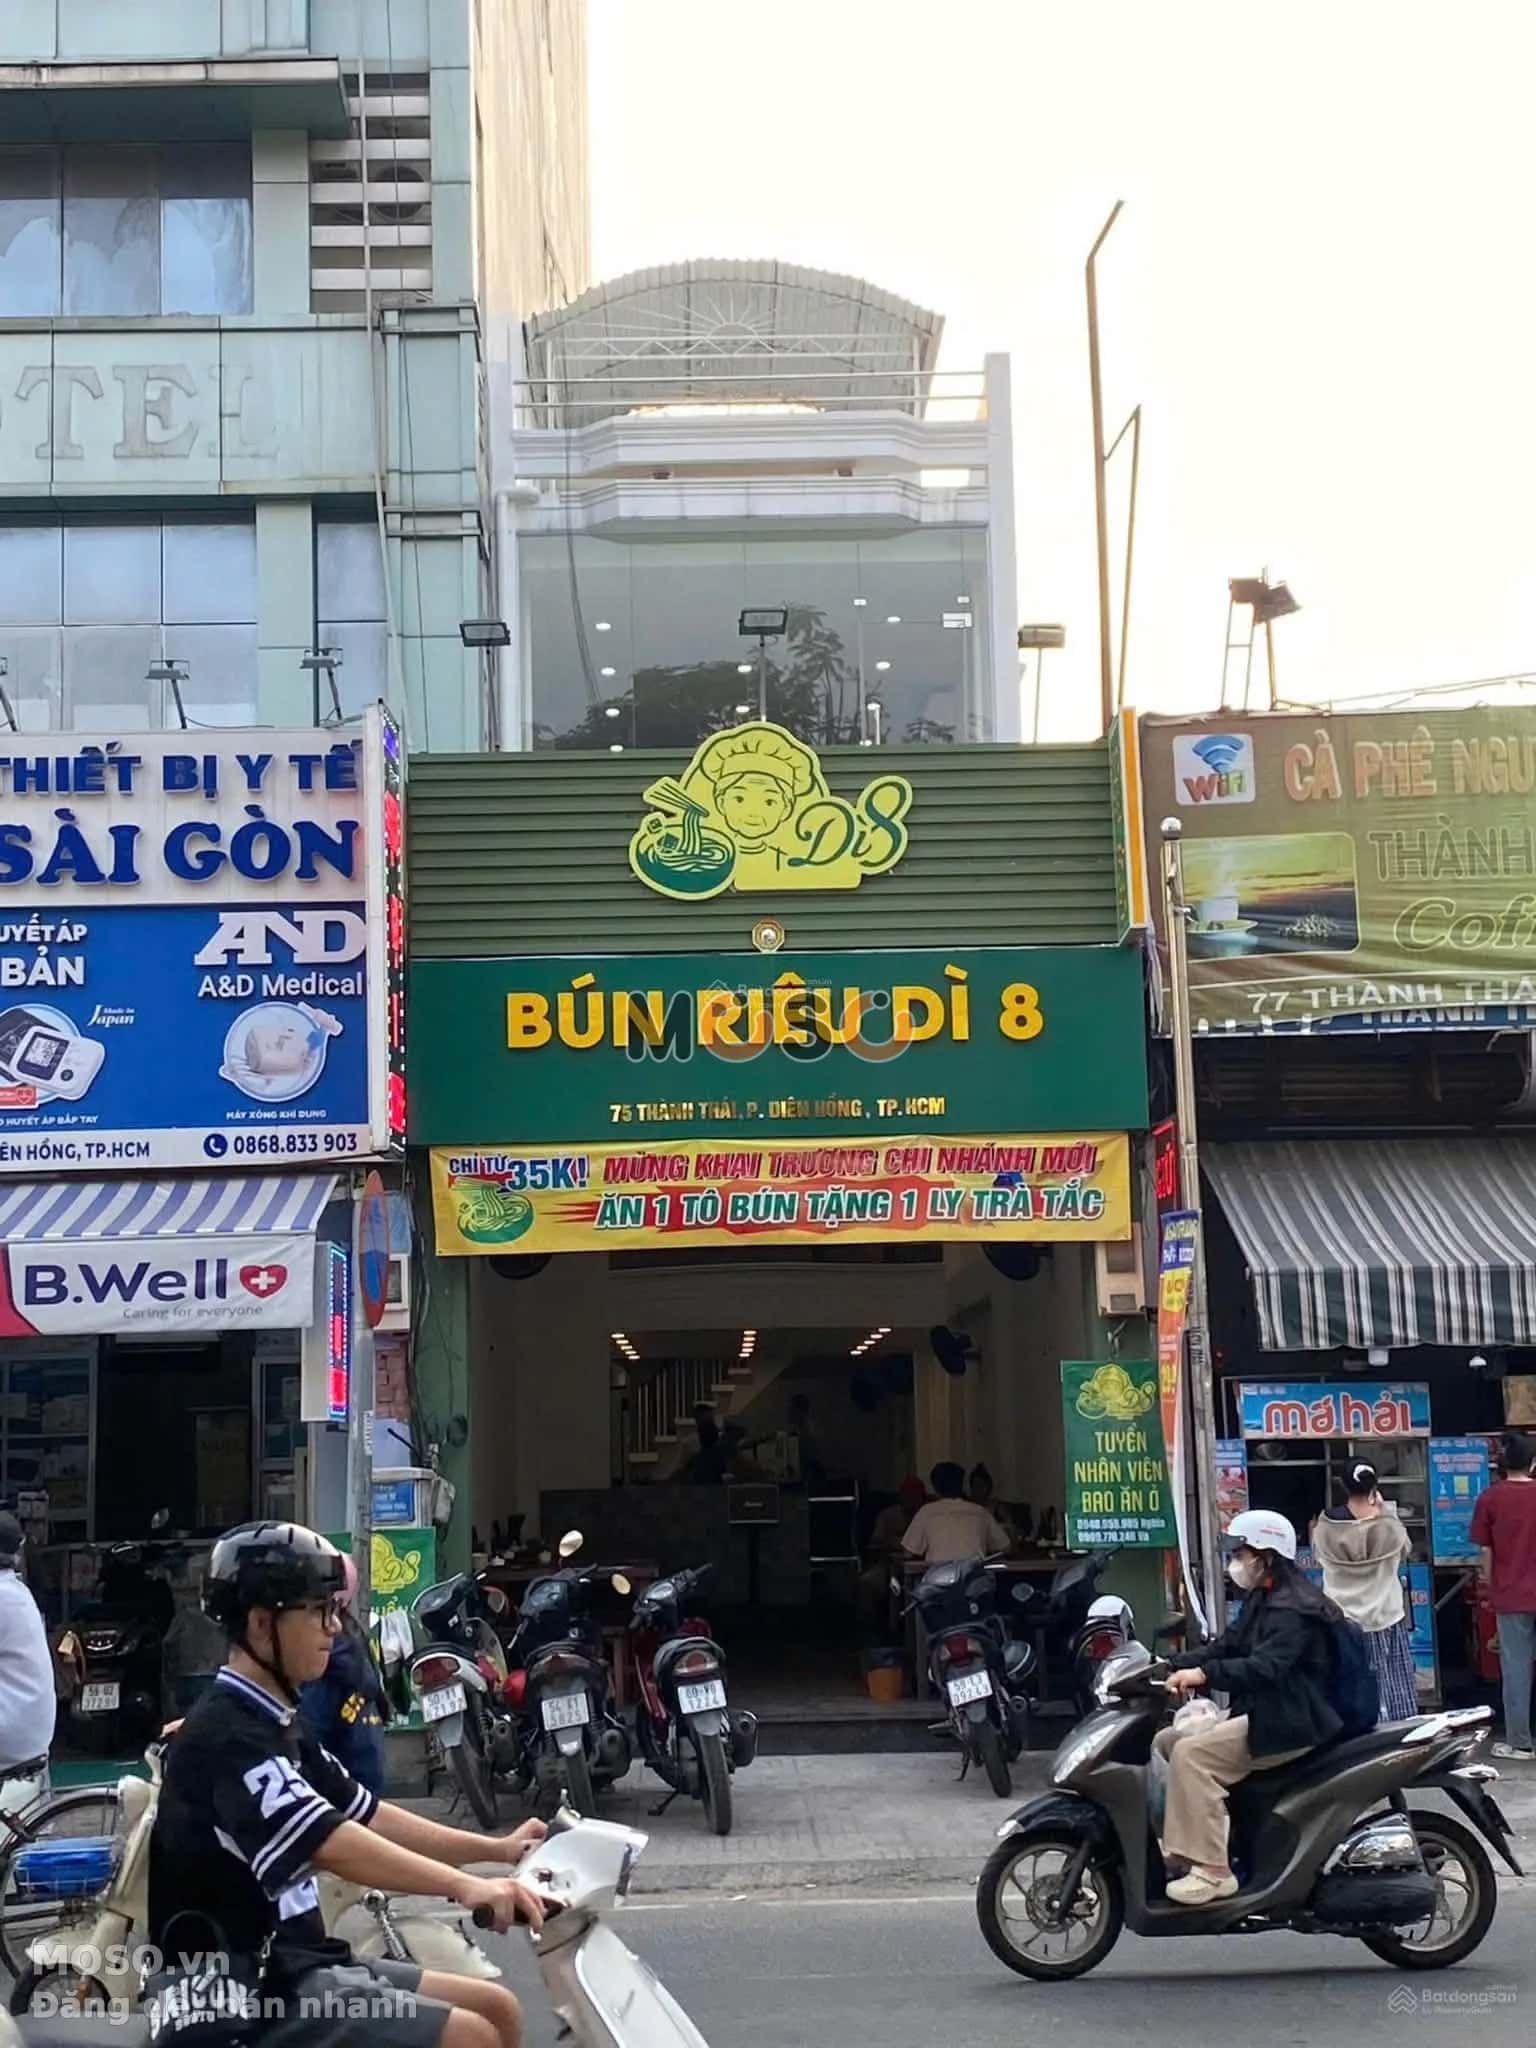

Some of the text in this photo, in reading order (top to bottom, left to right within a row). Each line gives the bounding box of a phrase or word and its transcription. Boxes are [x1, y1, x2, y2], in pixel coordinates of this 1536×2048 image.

[0, 740, 362, 799] THIẾT BỊ Y TẾ
[1353, 725, 1437, 799] PHÊ
[0, 804, 360, 884] SÀI GÒN
[1368, 813, 1536, 881] THÀNH
[56, 918, 88, 943] ÁP
[194, 911, 366, 965] AND
[0, 945, 85, 986] BẢN
[199, 973, 363, 997] A&D Medical
[1248, 991, 1289, 1014] 77
[1302, 980, 1443, 1008] THÀNH
[87, 1004, 135, 1028] Japan
[507, 973, 664, 1049] BÚN
[696, 971, 860, 1046] RIÊU
[892, 964, 968, 1041] DÌ
[1000, 984, 1043, 1040] 8
[80, 1115, 98, 1124] TAY
[298, 1109, 327, 1119] DUNG
[609, 1104, 632, 1122] 75
[636, 1098, 694, 1121] THÀNH
[26, 1138, 81, 1161] HỒNG,
[85, 1141, 150, 1159] TP.HCM
[233, 1133, 357, 1153] 0868.833 903
[449, 1151, 588, 1190] CHỈ TỪ 35K!
[604, 1140, 1099, 1182] MỪNG KHAI TRƯƠNG CHI NHÁNH MỚI
[595, 1177, 1105, 1228] ĂN 1 TÔ BÚN TẶNG 1 LY TRÀ TẮC
[23, 1257, 228, 1306] B.Well
[123, 1304, 263, 1319] Caring for everyone
[1074, 1456, 1162, 1483] NHÂN VIÊN
[1082, 1491, 1114, 1513] BAO
[1120, 1485, 1143, 1513] ĂN
